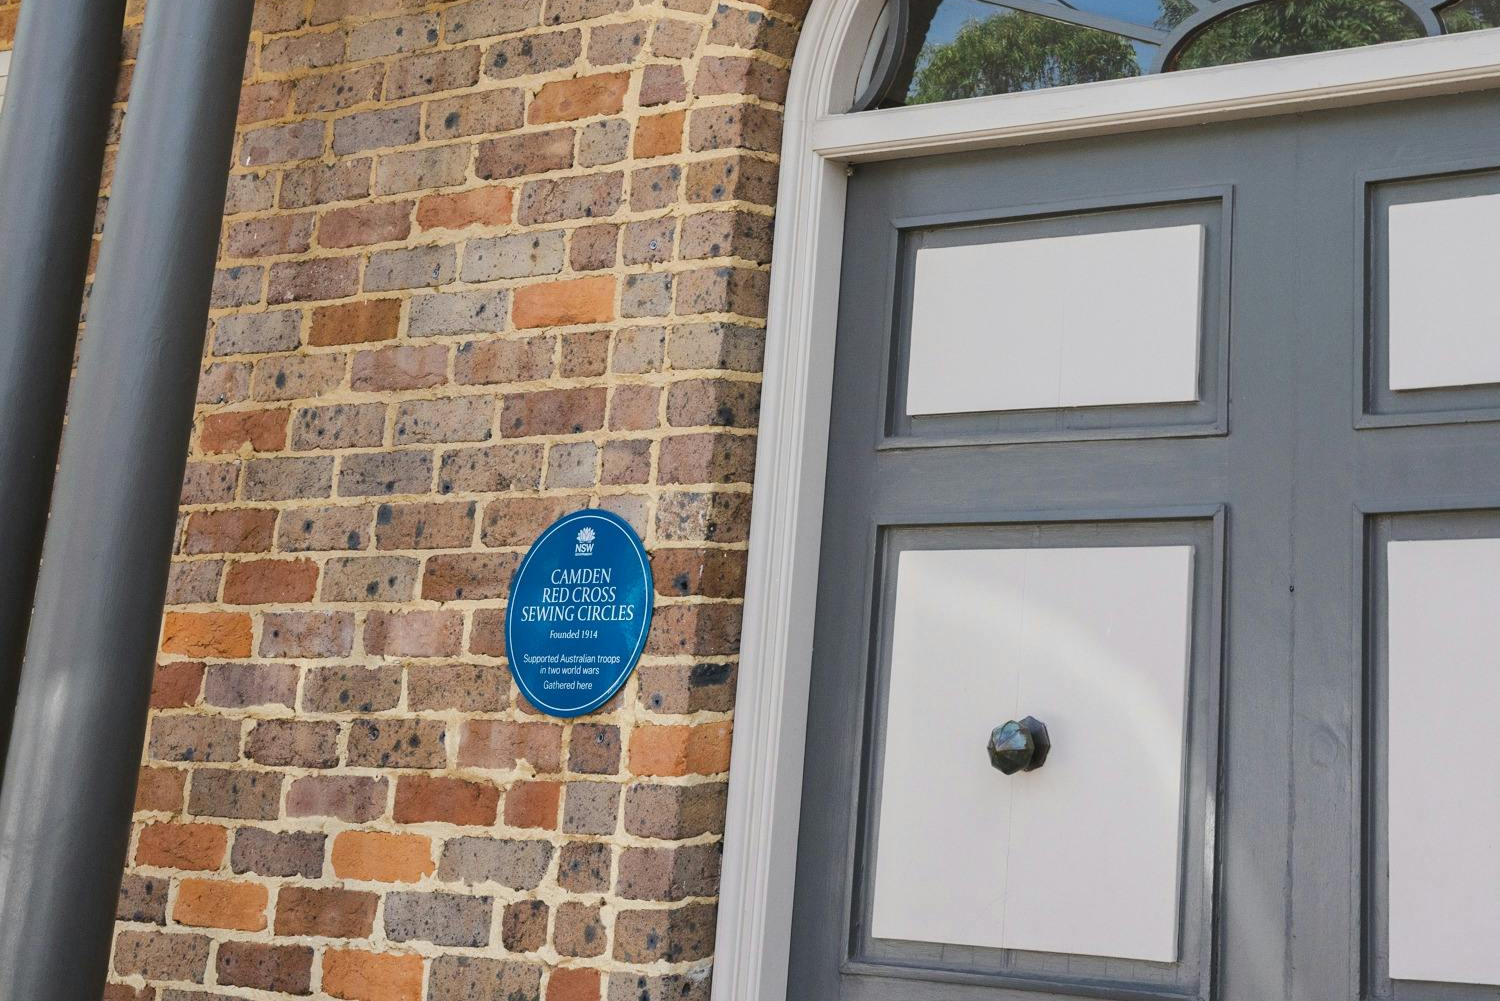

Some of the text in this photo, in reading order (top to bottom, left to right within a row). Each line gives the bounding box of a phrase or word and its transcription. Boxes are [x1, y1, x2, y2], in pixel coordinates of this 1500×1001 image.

[575, 544, 594, 552] NSW
[551, 568, 611, 584] CAMDEN
[542, 587, 616, 603] RED CROSS
[521, 605, 634, 621] SEWING CIRCLES
[550, 630, 598, 639] Founded 1914
[523, 654, 620, 664] Supported Australian troops
[540, 665, 546, 674] in
[547, 666, 560, 674] two
[562, 665, 581, 674] world
[544, 681, 592, 690] Gathered here
